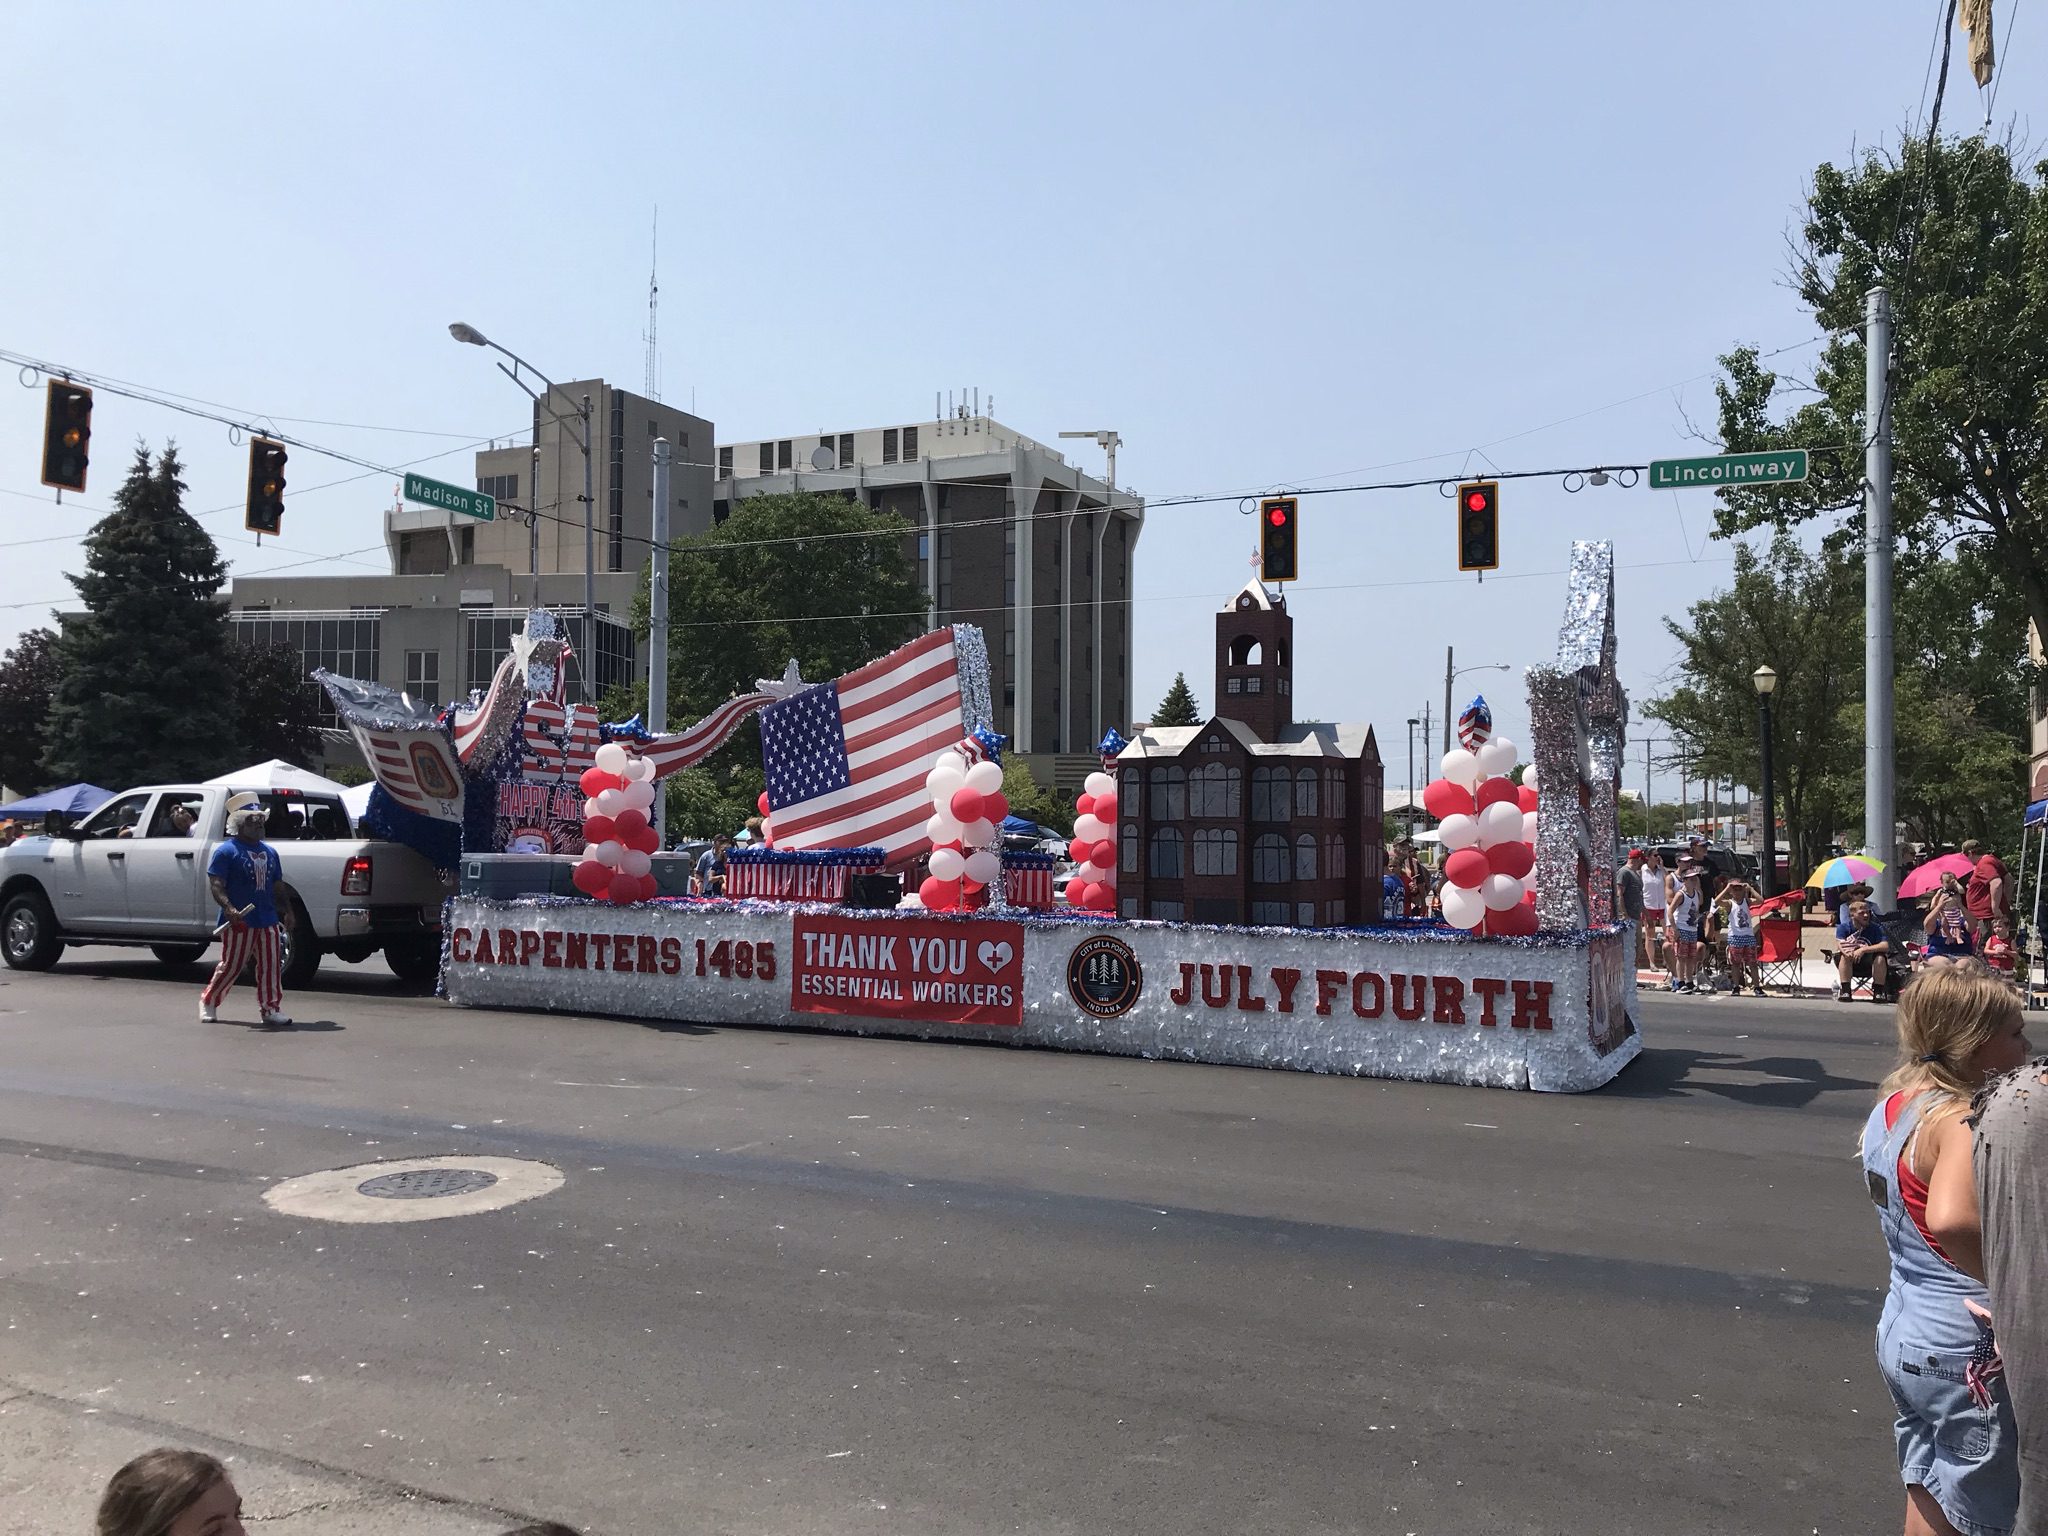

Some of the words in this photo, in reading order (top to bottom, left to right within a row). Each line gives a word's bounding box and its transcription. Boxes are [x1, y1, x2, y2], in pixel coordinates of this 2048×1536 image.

[1659, 461, 1796, 482] Lincolnway
[411, 480, 468, 510] Madison
[475, 500, 489, 515] St
[499, 782, 550, 819] HAPPY
[552, 787, 577, 821] 4th
[452, 927, 681, 975] CARPENTERS
[695, 938, 777, 981] 1485
[801, 931, 898, 972] THANK
[908, 937, 968, 976] YOU
[1080, 944, 1093, 957] CITY
[1110, 943, 1130, 960] PORTE
[801, 974, 904, 1000] ESSENTIAL
[912, 979, 1013, 1007] WORKERS
[1086, 1001, 1121, 1014] INDIANA
[1170, 962, 1301, 1013] JULY
[1315, 969, 1554, 1031] FOURTH
